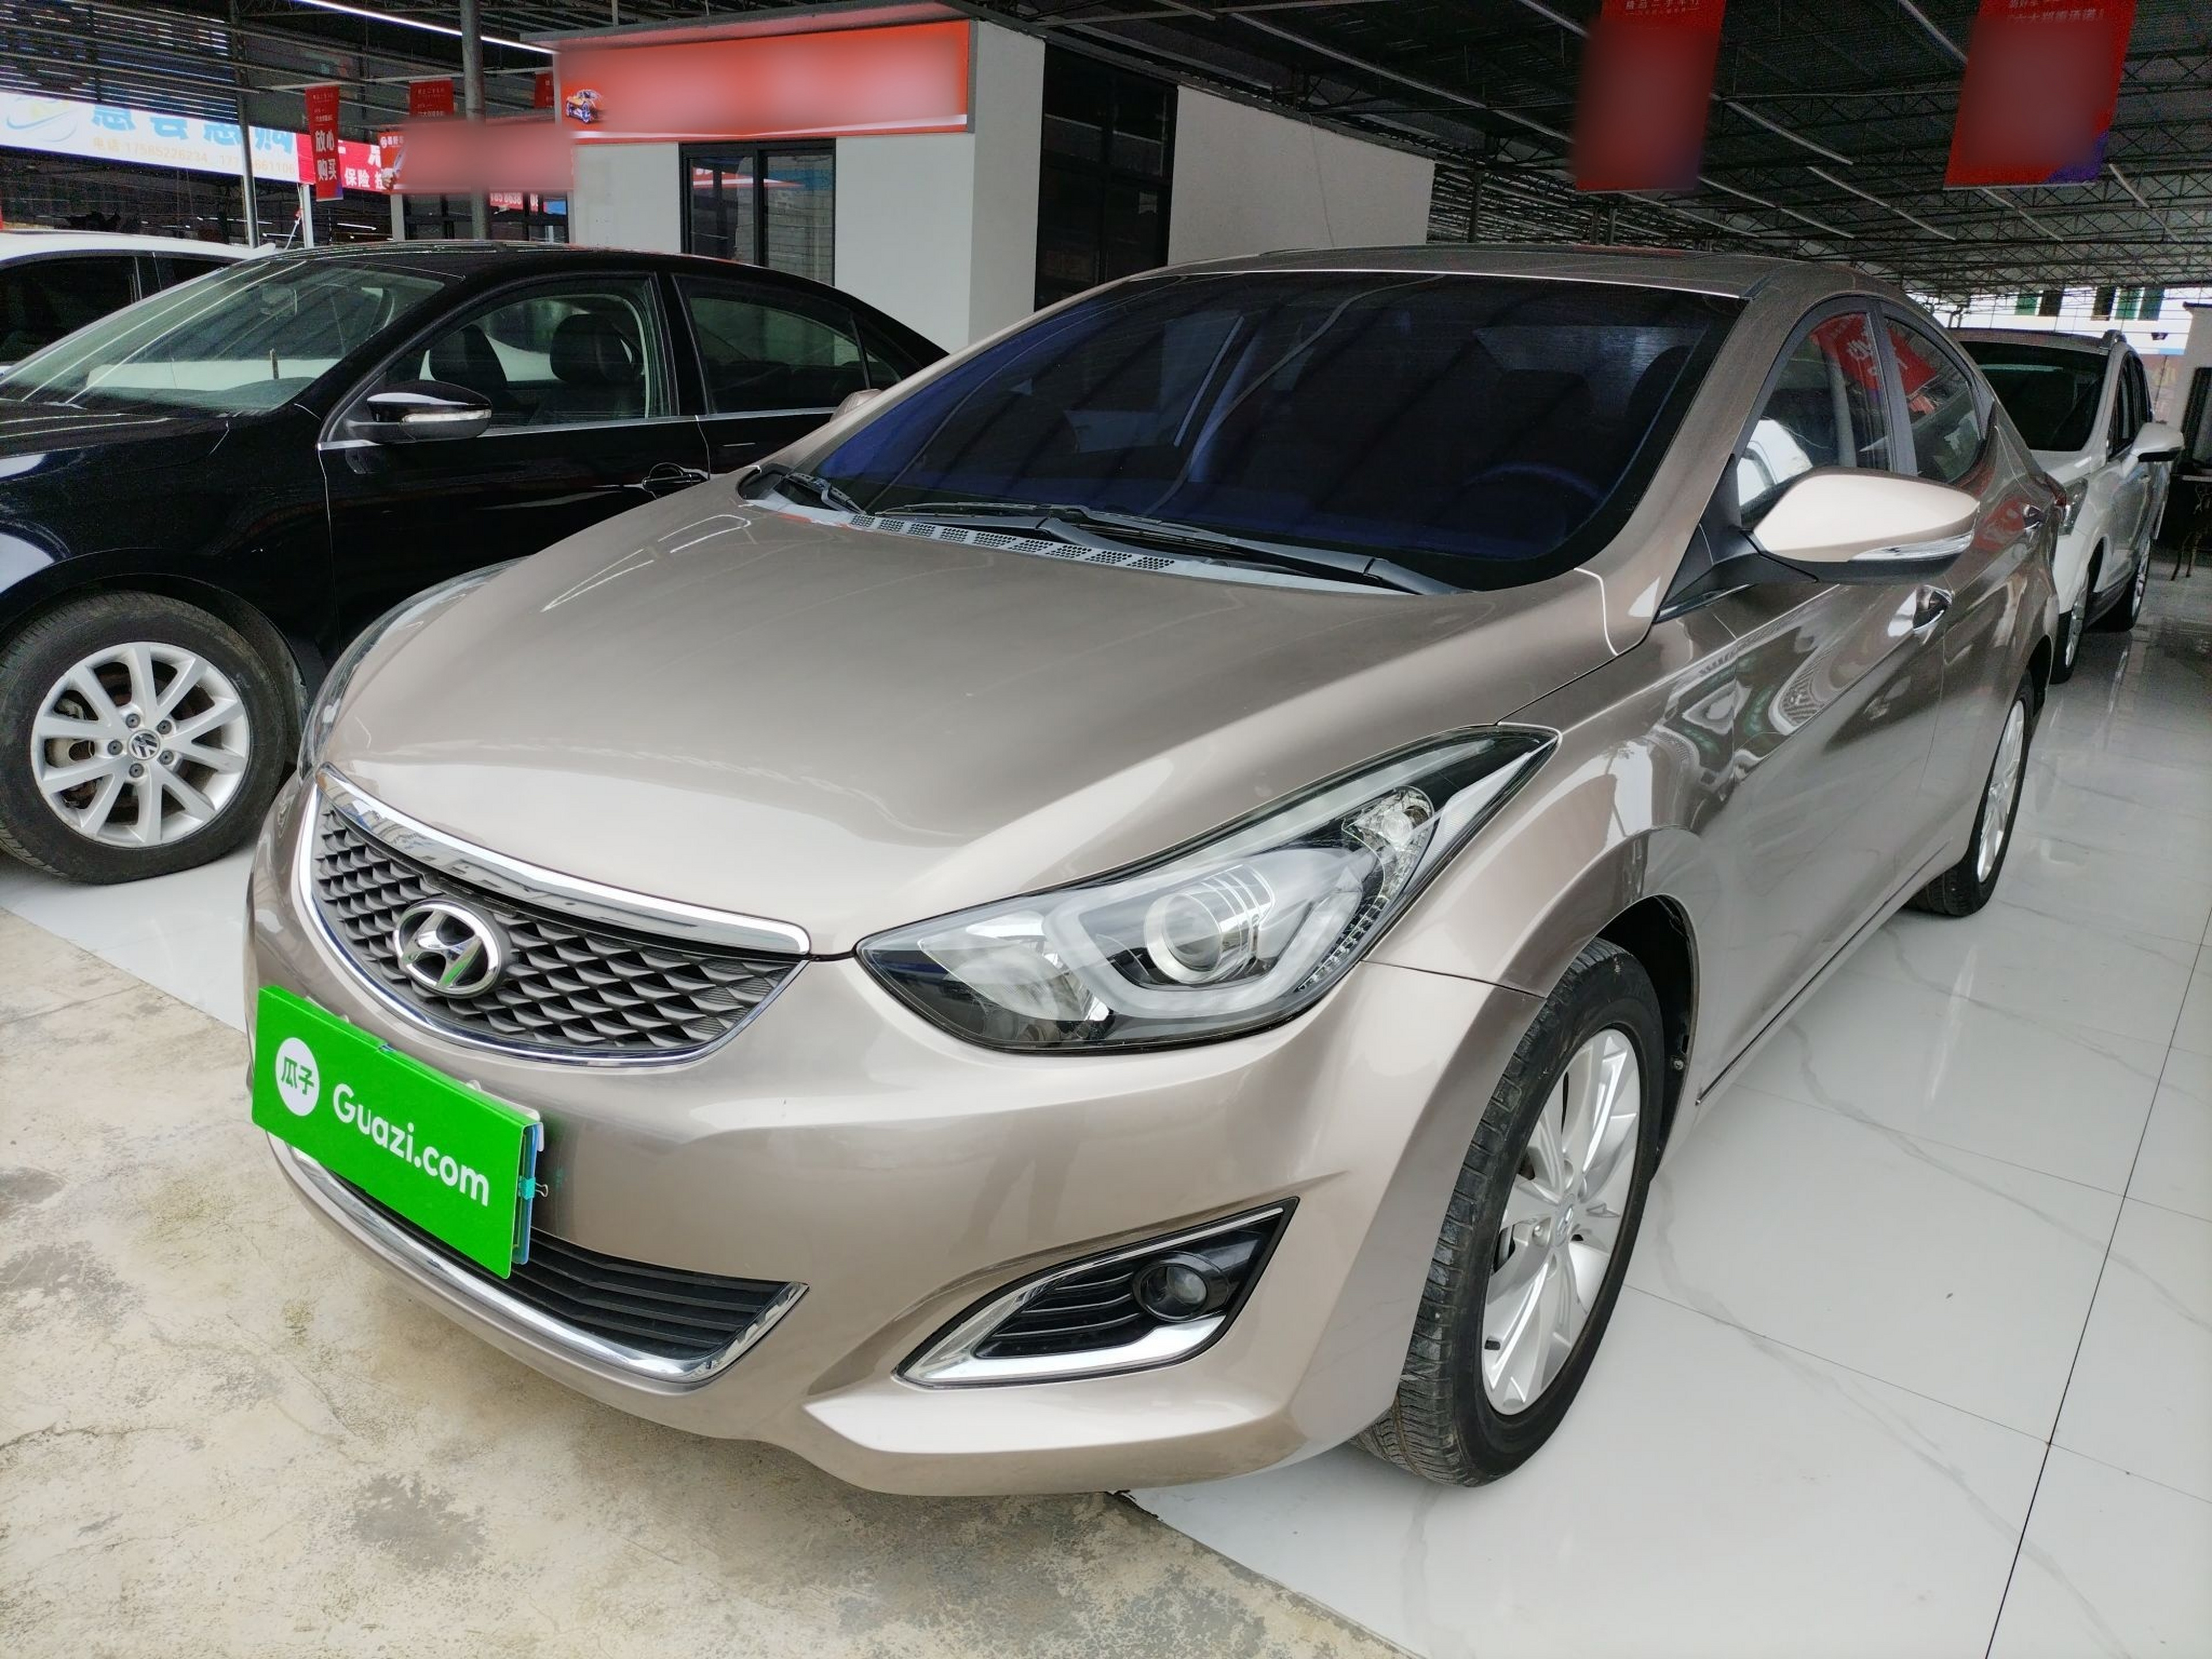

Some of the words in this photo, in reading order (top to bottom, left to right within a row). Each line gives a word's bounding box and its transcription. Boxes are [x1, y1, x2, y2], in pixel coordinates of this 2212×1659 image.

[315, 130, 335, 152] 放心
[317, 158, 337, 181] 购买
[344, 168, 370, 188] 保险
[281, 1056, 314, 1095] 瓜子
[333, 1084, 488, 1206] Guazi.com
